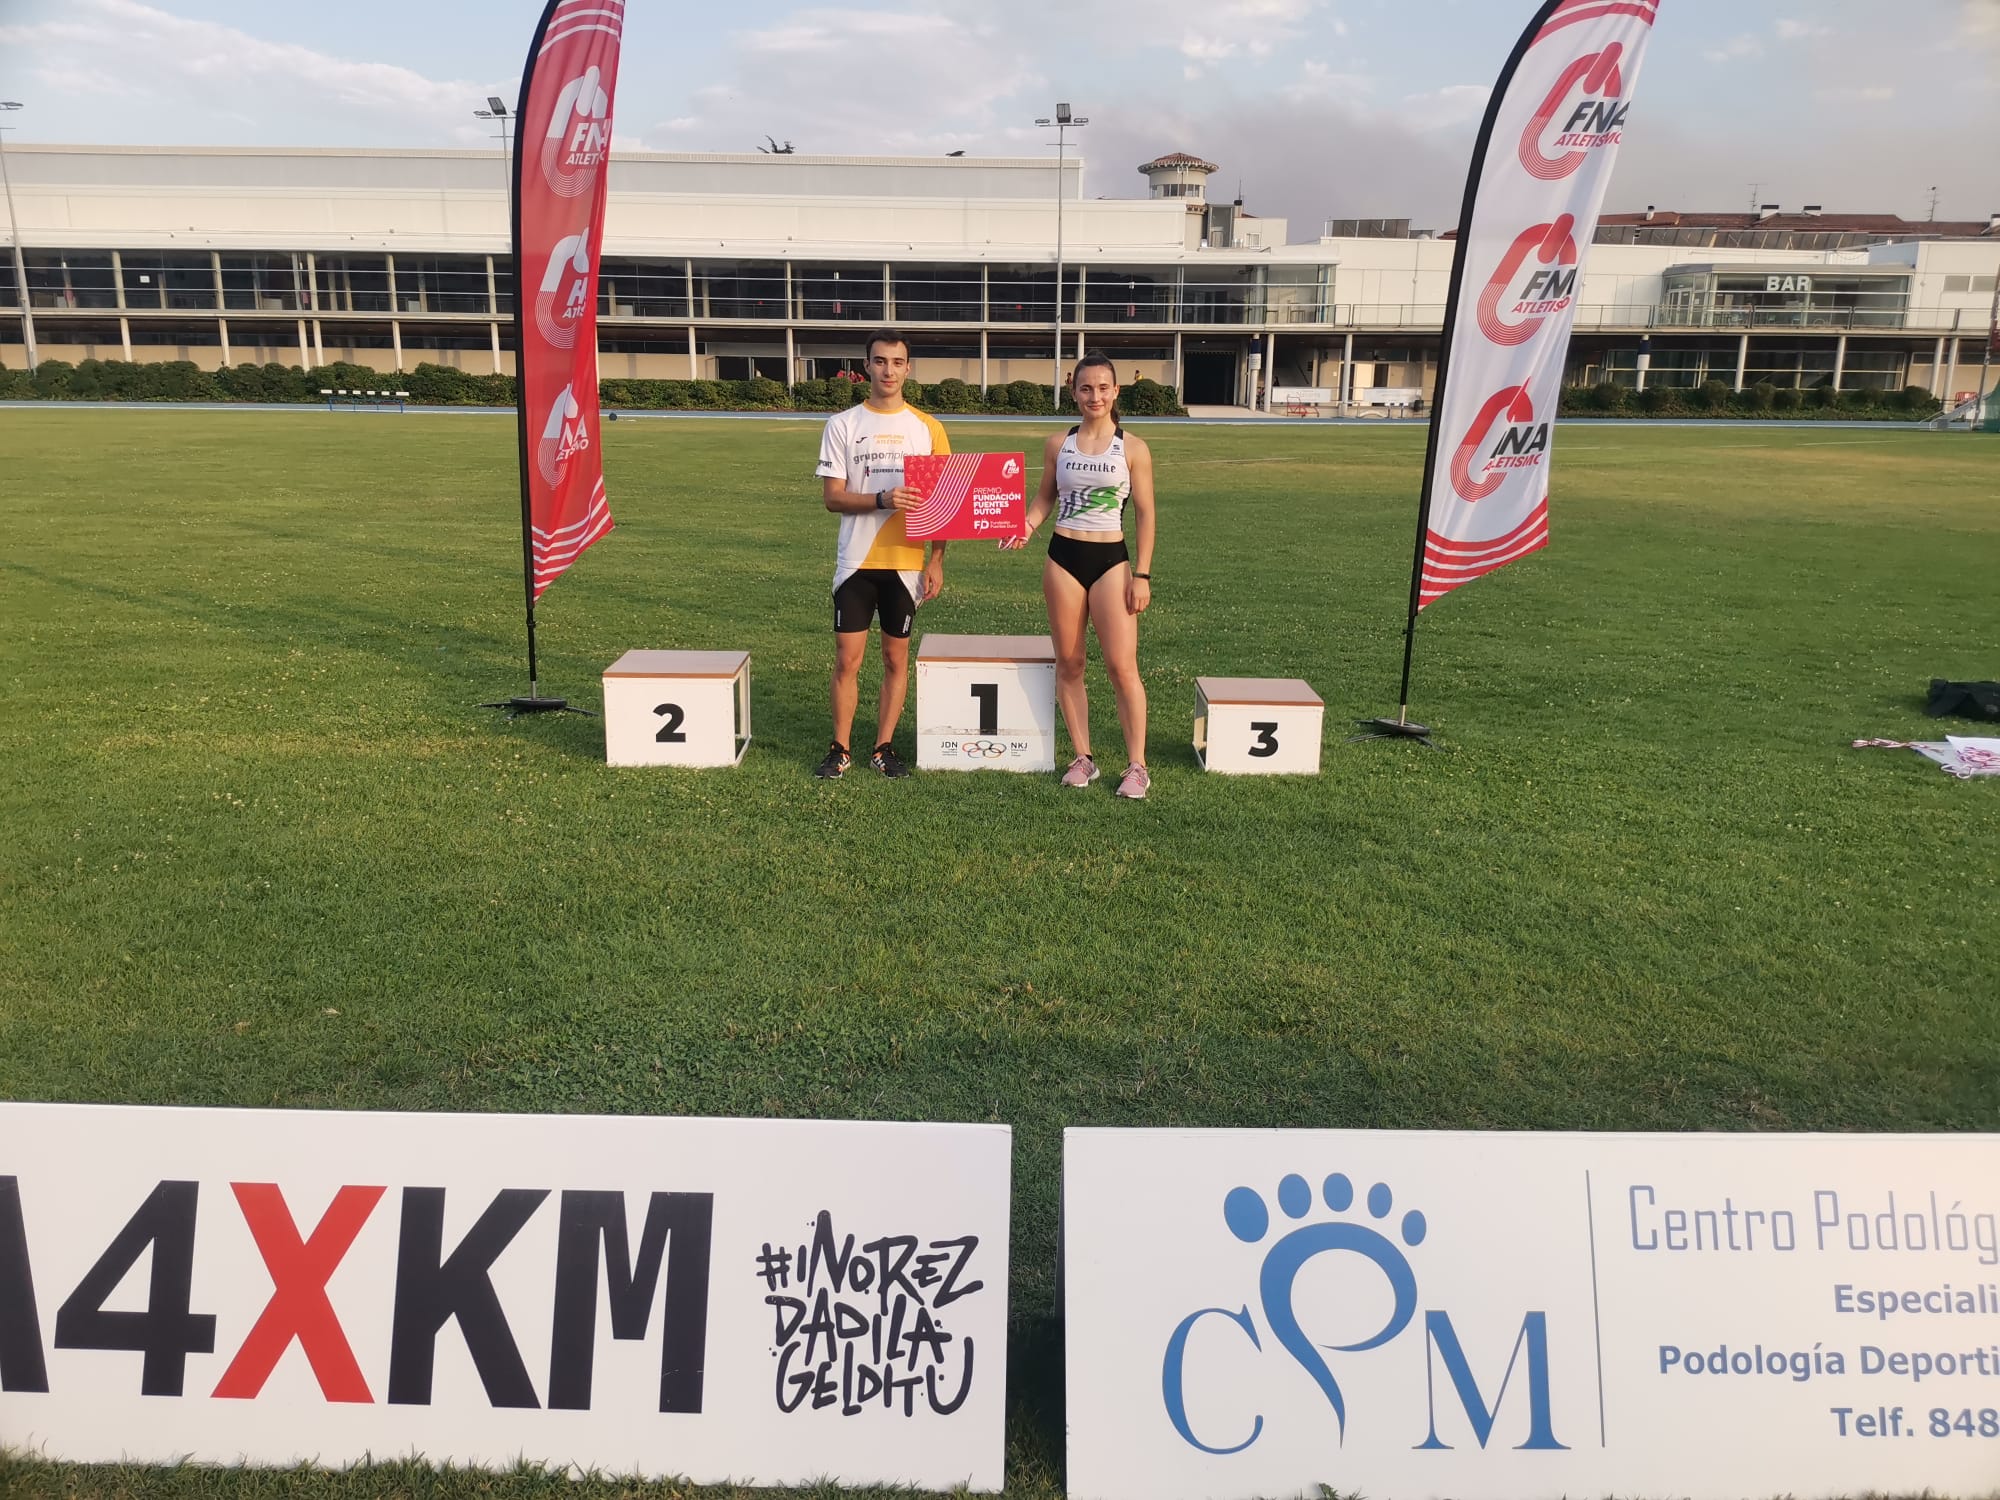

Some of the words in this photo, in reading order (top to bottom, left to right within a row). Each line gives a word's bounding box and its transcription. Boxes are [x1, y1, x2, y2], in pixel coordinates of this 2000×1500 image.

[1766, 276, 1810, 292] BAR
[973, 487, 1002, 495] PREMIO
[973, 491, 1022, 502] FUNDACIÓN
[973, 500, 1010, 508] FUENTES
[973, 508, 1002, 516] DUTOR
[970, 684, 999, 736] 1
[652, 703, 687, 743] 2
[940, 741, 958, 749] JDN
[1247, 721, 1280, 758] 3
[1629, 1185, 1796, 1251] Centro
[1659, 1343, 1846, 1382] Podología
[1830, 1406, 1915, 1437] Telf.
[1928, 1408, 2000, 1438] 848
